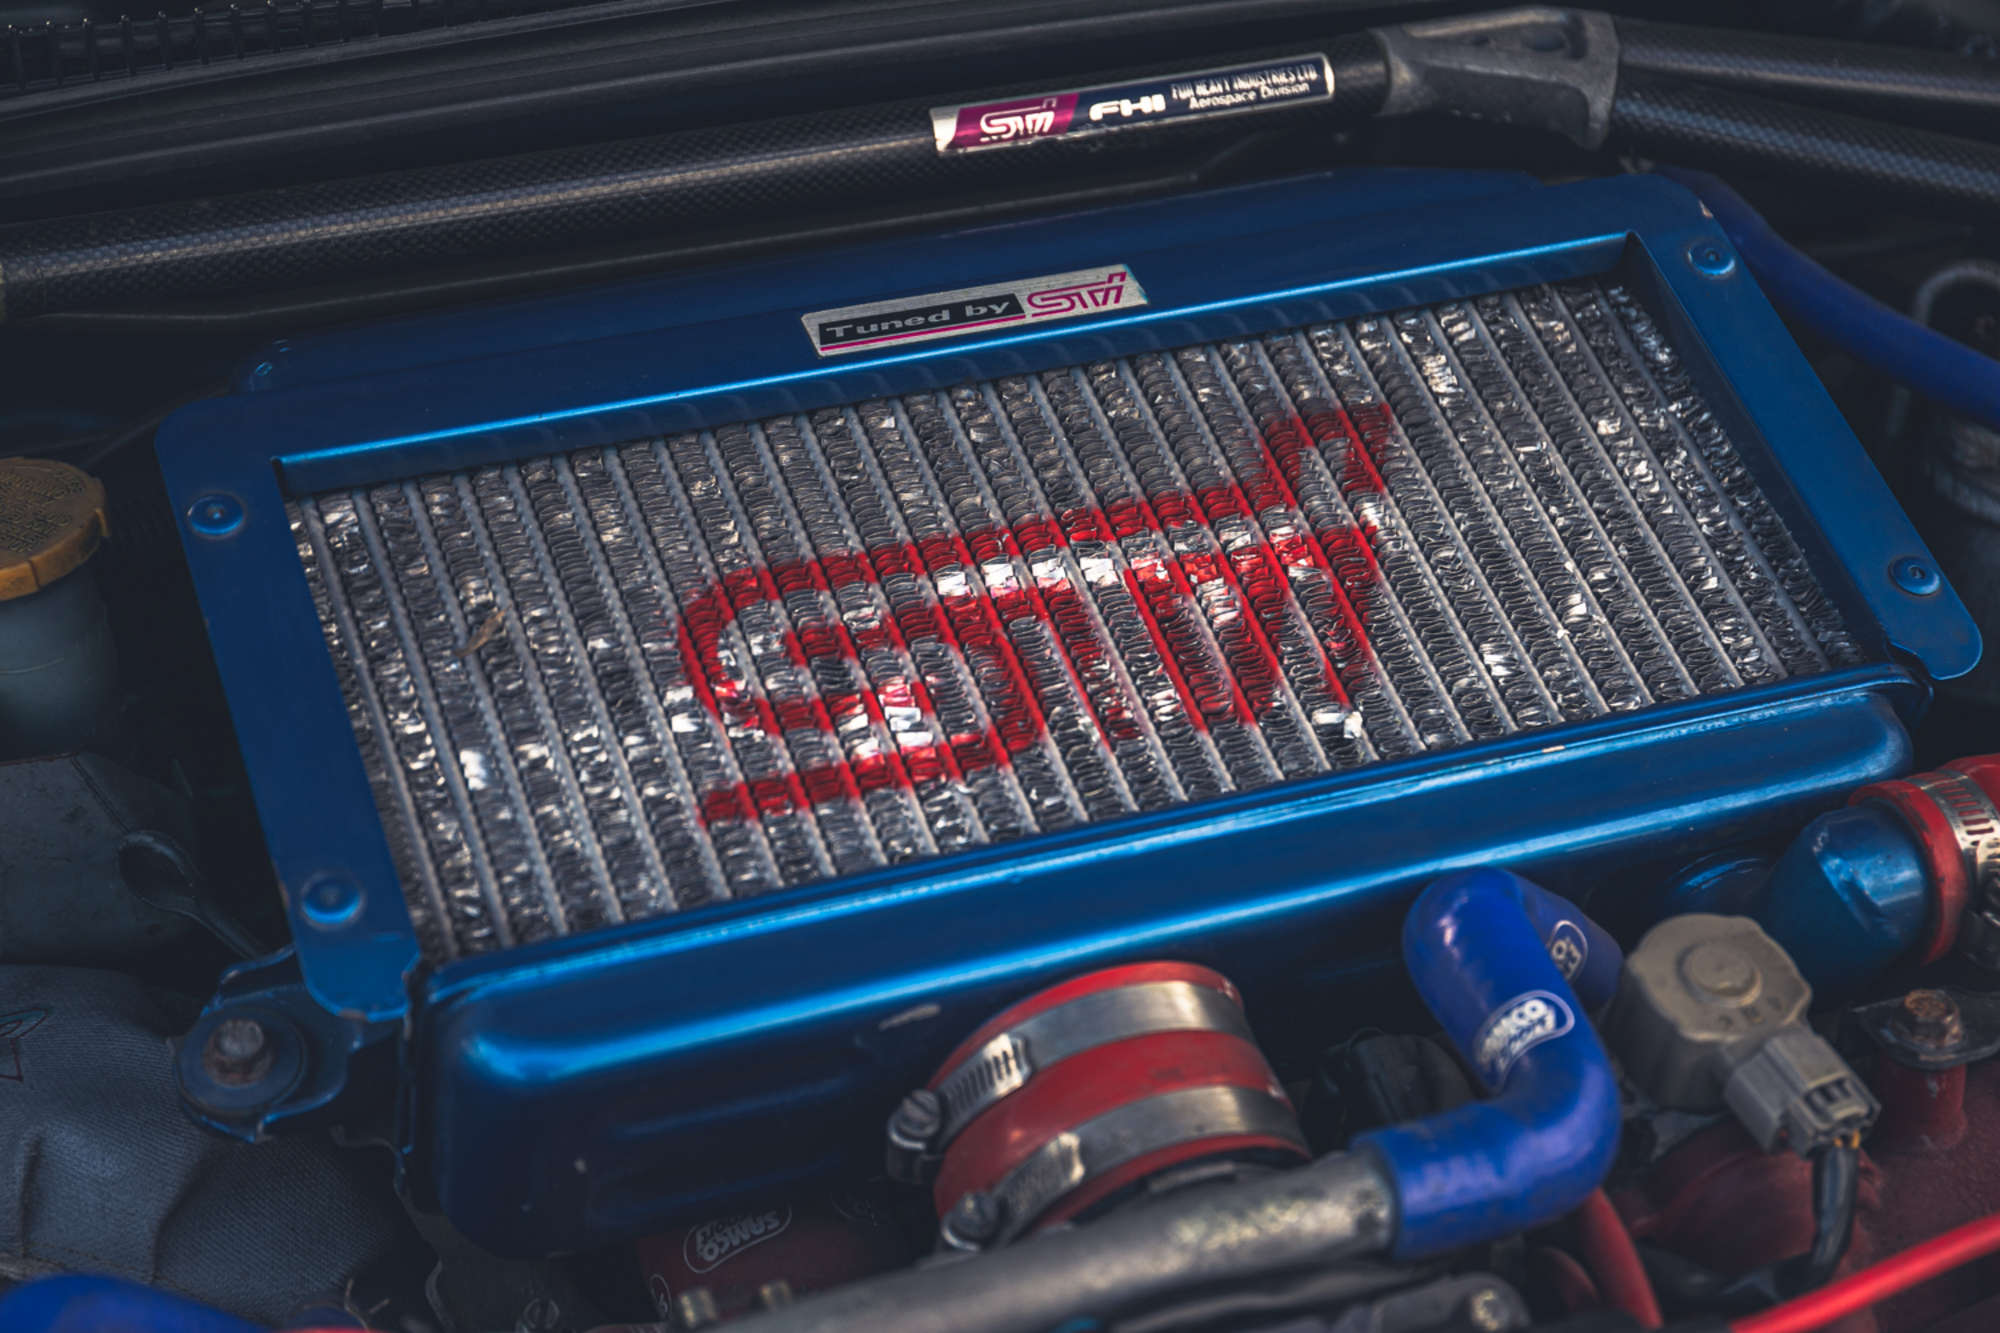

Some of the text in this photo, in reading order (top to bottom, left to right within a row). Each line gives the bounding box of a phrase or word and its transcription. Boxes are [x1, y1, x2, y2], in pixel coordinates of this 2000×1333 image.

[1233, 67, 1296, 90] INDUSTRIES
[1089, 94, 1166, 121] FHI
[1189, 82, 1311, 110] Aerospace Division
[826, 310, 950, 339] Tuned
[966, 299, 1011, 322] by
